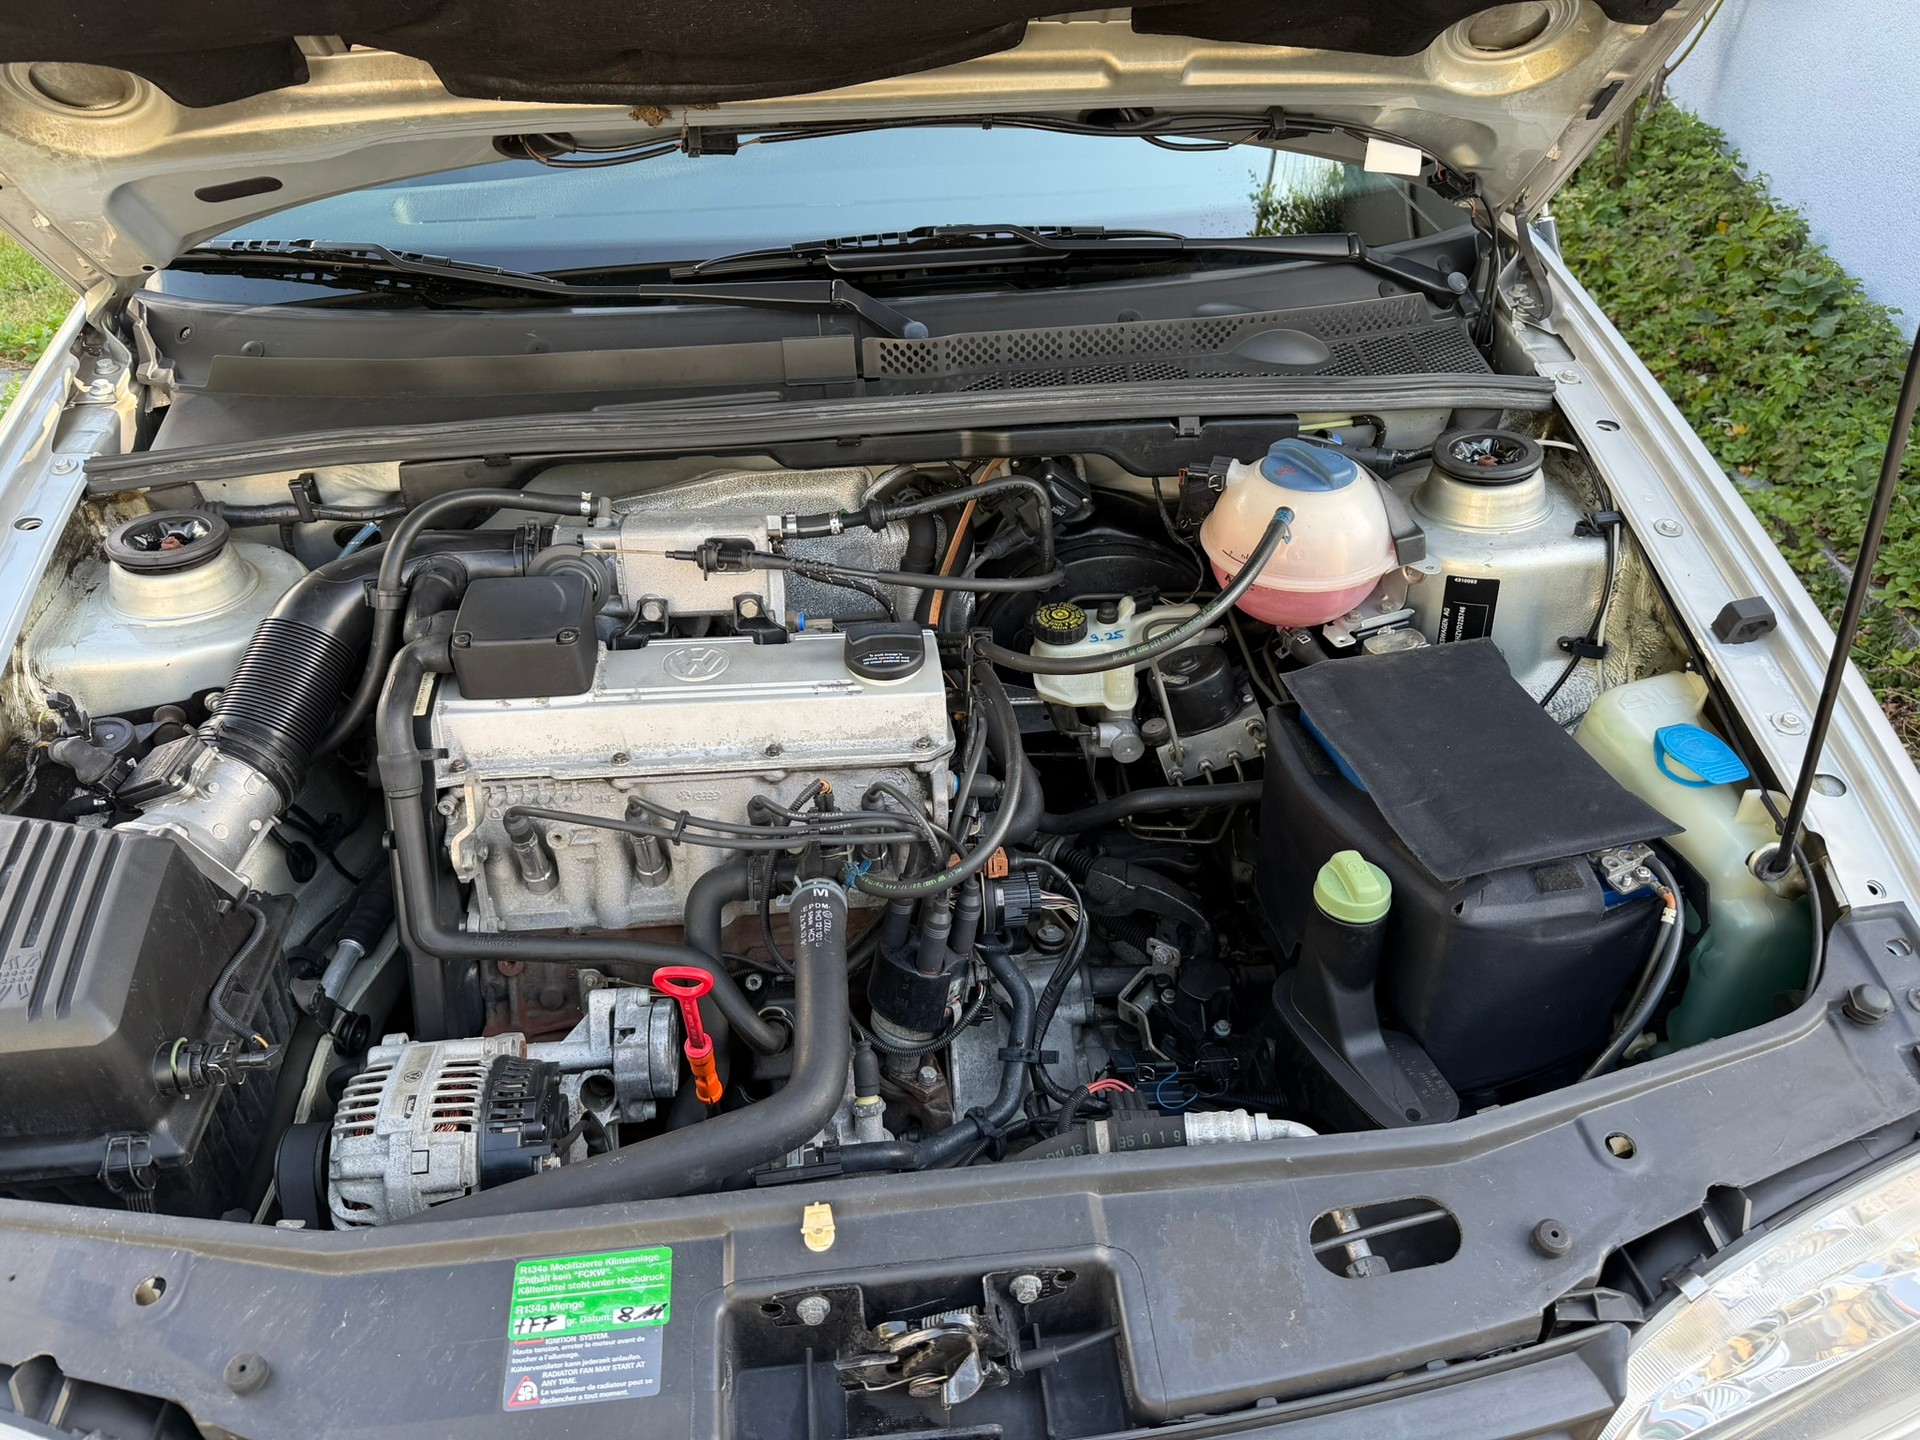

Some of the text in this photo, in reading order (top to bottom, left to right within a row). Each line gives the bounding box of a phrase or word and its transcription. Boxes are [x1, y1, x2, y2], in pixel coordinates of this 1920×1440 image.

[1443, 607, 1450, 617] AG
[1089, 629, 1126, 643] 9.25
[813, 888, 829, 898] M
[520, 1254, 660, 1275] R134a Modifizierte Klimaanlage
[517, 1273, 666, 1295] Kältemittel steht unter Hochdruck
[518, 1274, 551, 1285] Enthält
[552, 1273, 572, 1281] kein
[515, 1300, 585, 1315] R134a Menge
[579, 1313, 613, 1324] Datum:
[512, 1347, 533, 1355] Haute
[591, 1339, 616, 1347] moteur
[616, 1336, 636, 1345] avant
[545, 1335, 577, 1345] IGNITION
[510, 1362, 563, 1374] Kühlerventilator
[564, 1359, 582, 1367] kann
[582, 1356, 611, 1367] jederzeit
[511, 1355, 538, 1364] toucher
[541, 1360, 646, 1378] RADIATOR FAN MAY START AT
[540, 1377, 654, 1396] Le ventilateur de radiateur peut se
[541, 1379, 558, 1388] ANY
[540, 1394, 578, 1405] declencher
[583, 1391, 599, 1400] tout
